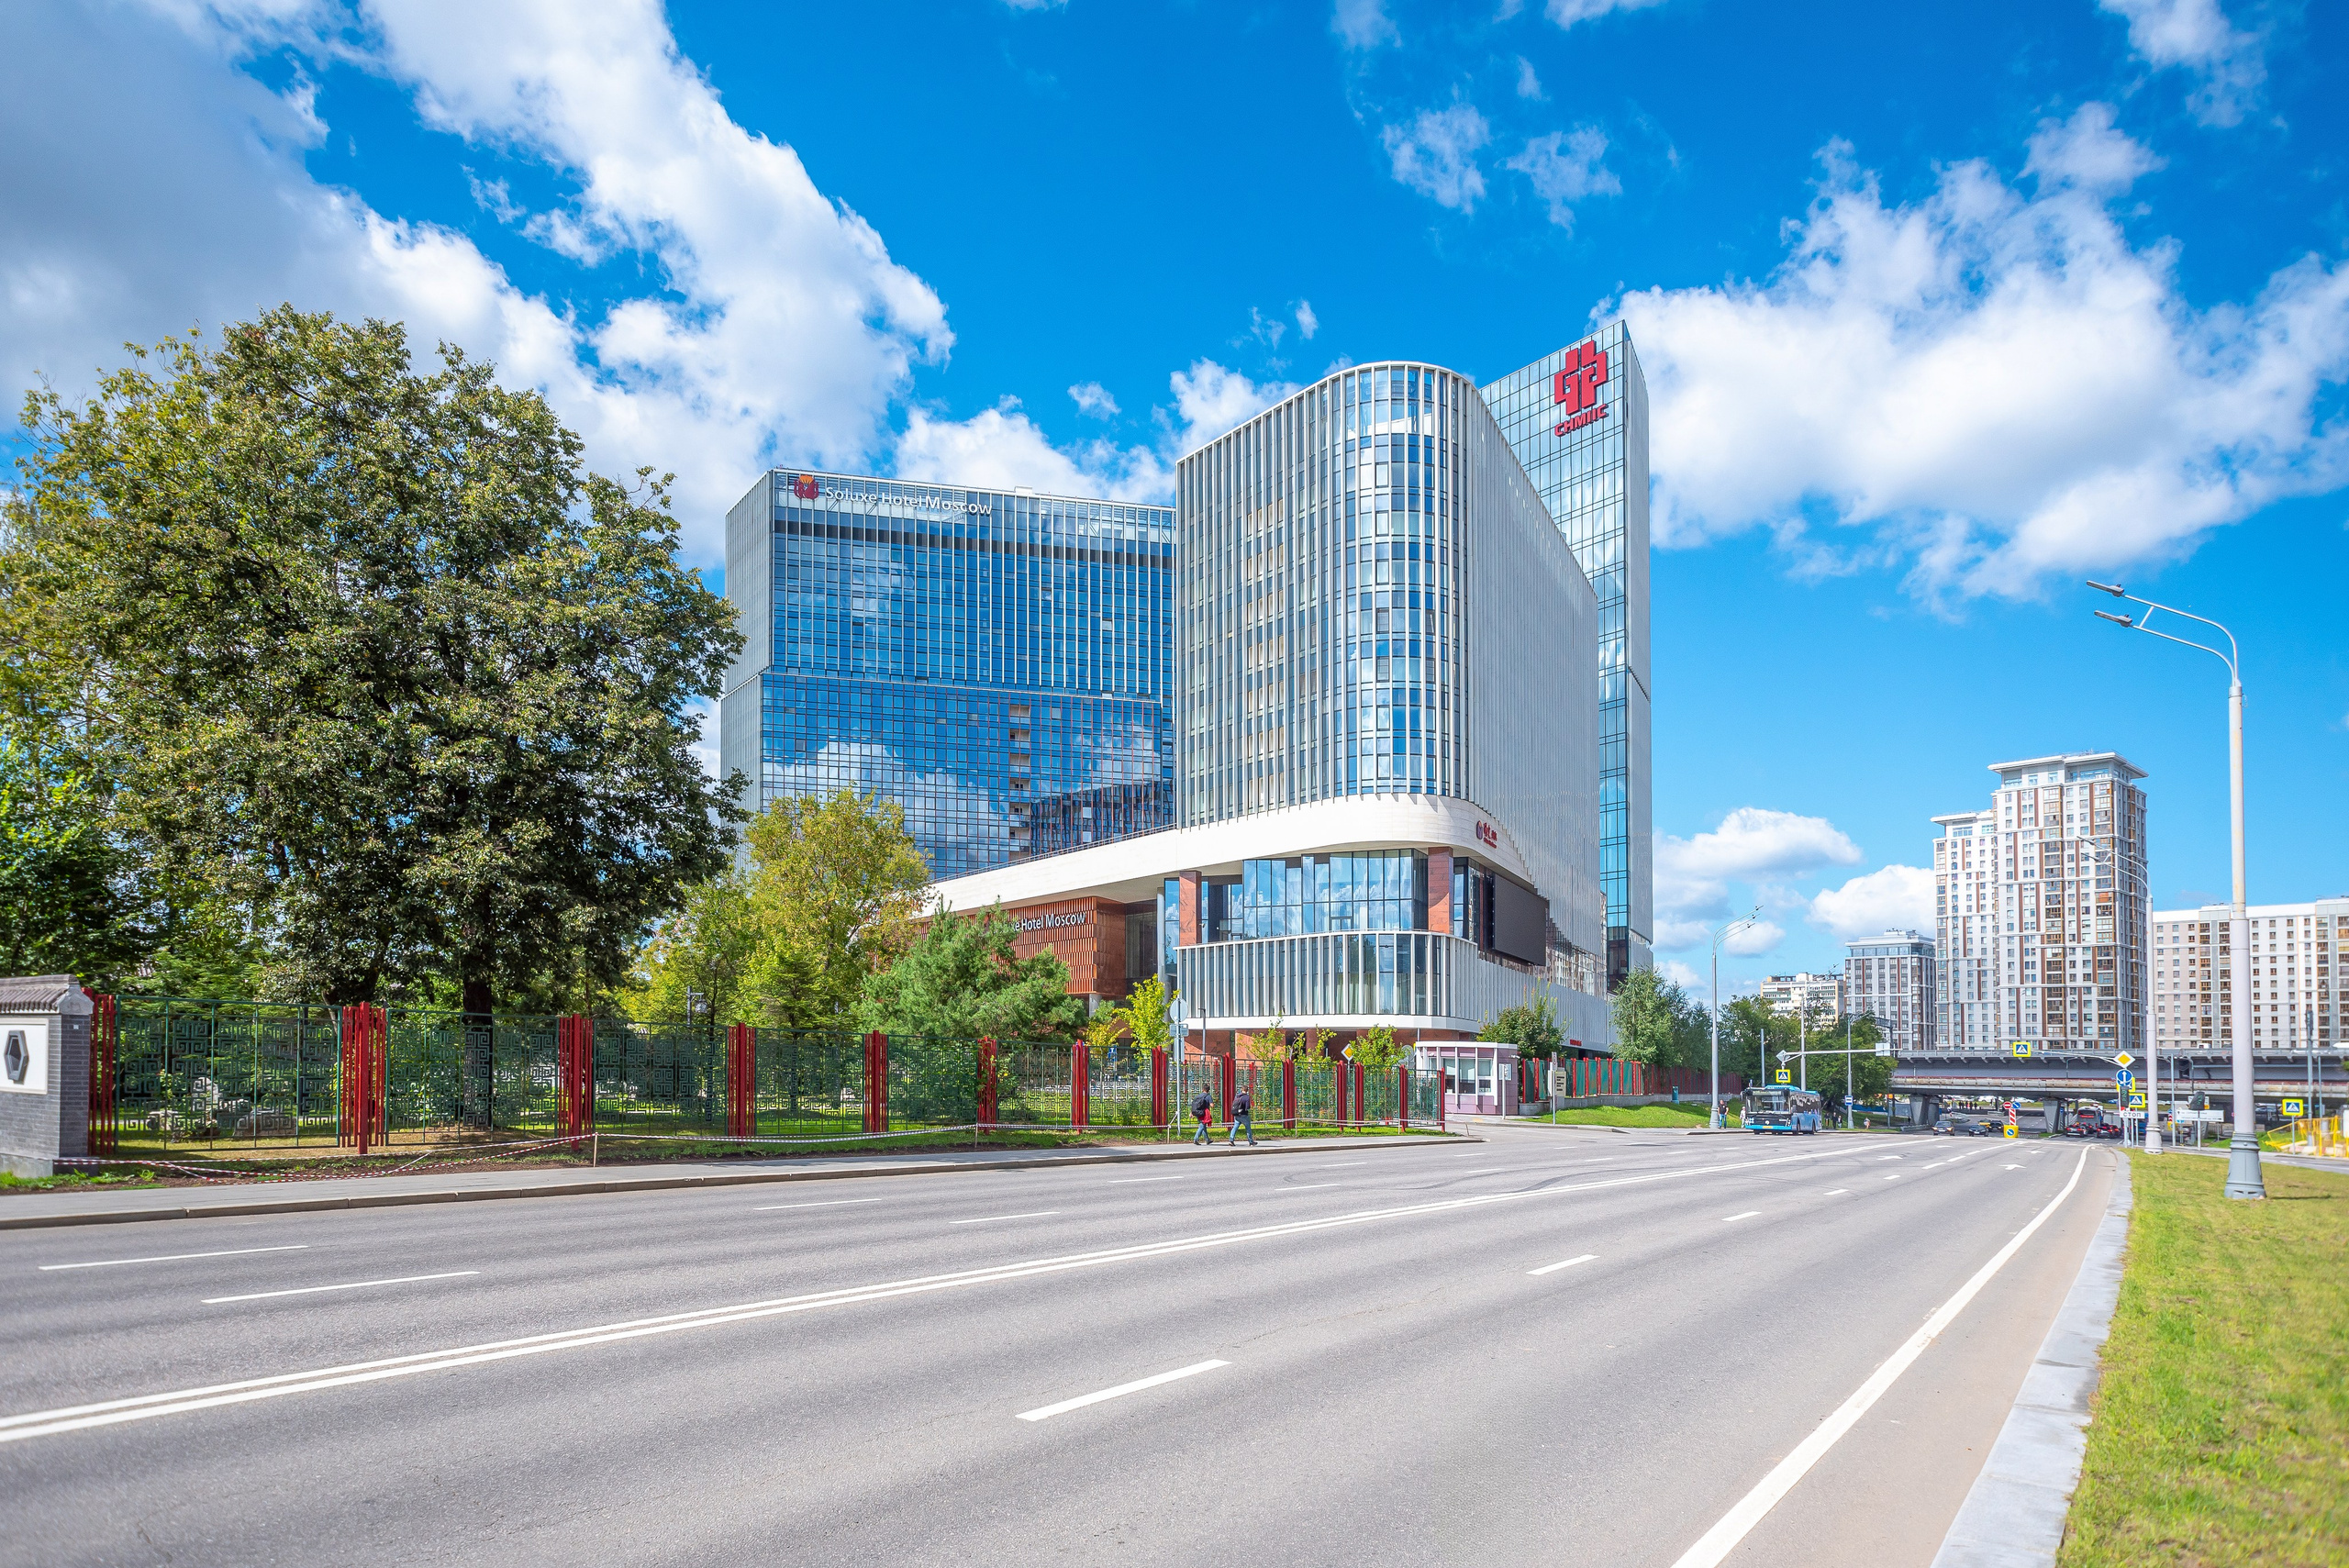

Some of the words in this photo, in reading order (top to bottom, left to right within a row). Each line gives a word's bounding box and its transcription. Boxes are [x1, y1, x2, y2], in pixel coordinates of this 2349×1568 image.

[1554, 403, 1609, 437] CHMIIC
[825, 486, 878, 504] Soluxe
[881, 492, 922, 507] Hotel
[925, 495, 992, 516] Moscow
[1021, 917, 1044, 931] Hotel
[1045, 911, 1086, 928] Moscow
